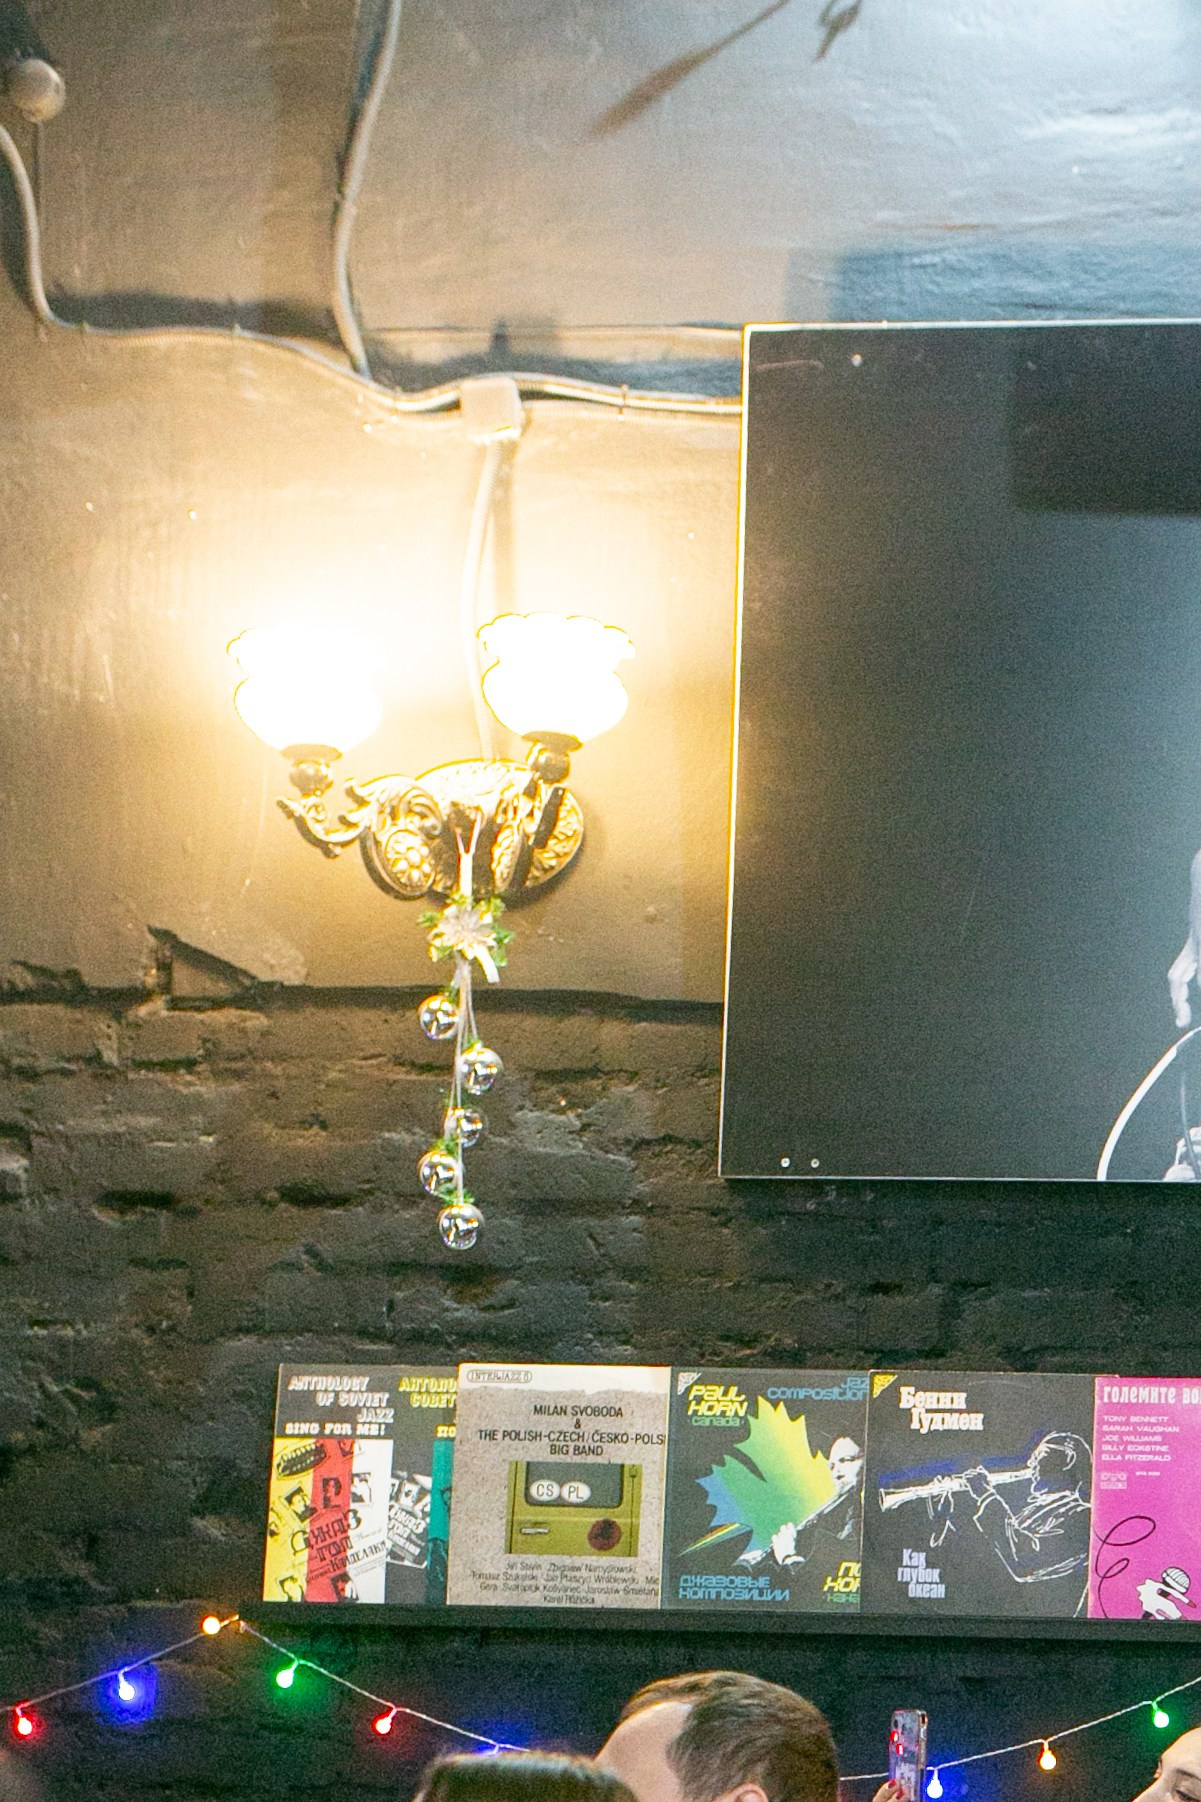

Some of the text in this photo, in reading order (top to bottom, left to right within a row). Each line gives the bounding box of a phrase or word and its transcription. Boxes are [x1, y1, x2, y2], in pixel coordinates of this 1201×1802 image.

[287, 1376, 370, 1391] ANTHOLOGY
[338, 1392, 389, 1407] SOVIET
[899, 1386, 967, 1409] Бенни
[533, 1404, 624, 1418] MILAN SVOBODA
[687, 1400, 749, 1416] HORN
[356, 1408, 394, 1423] JAZZ
[910, 1407, 984, 1434] Гудмен
[1130, 1415, 1169, 1423] BENNETT
[284, 1422, 386, 1436] SING FOR ME!
[574, 1418, 582, 1429] &
[1102, 1424, 1180, 1433] SARAH VAUGHAN
[478, 1429, 498, 1441] THE
[1102, 1434, 1119, 1442] JOE
[550, 1444, 604, 1456] BIG BAND
[1127, 1444, 1169, 1452] ECKSTINE
[1101, 1453, 1123, 1461] ELLA
[536, 1483, 554, 1497] CS
[568, 1485, 584, 1500] PL
[902, 1548, 927, 1568] Как
[897, 1566, 941, 1584] глубок
[908, 1583, 946, 1598] океан
